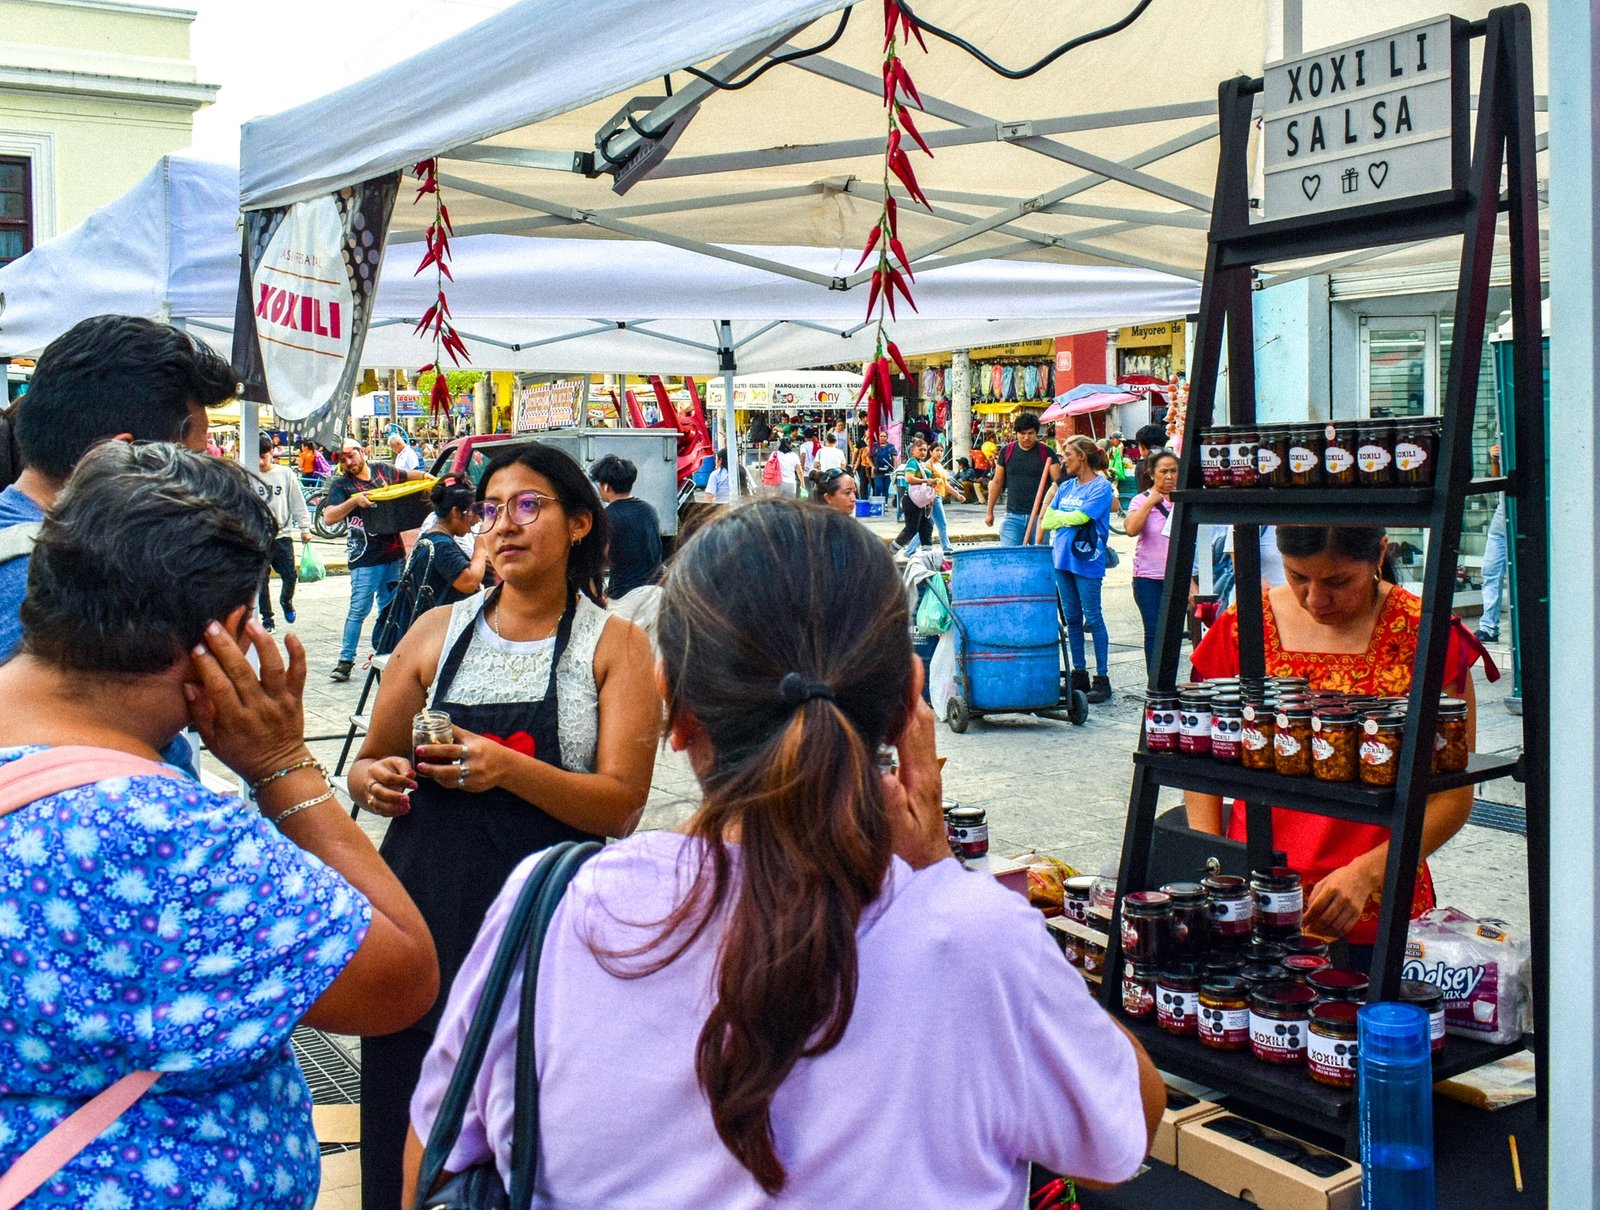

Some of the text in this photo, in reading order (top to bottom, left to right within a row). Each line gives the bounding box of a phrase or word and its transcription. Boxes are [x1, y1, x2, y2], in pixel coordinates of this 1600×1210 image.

[1286, 95, 1413, 157] SALSA
[257, 283, 342, 340] XOXILI
[1131, 321, 1182, 340] Mayoreo de
[1254, 1030, 1285, 1047] XOXILI
[1311, 1049, 1345, 1067] XOXILI
